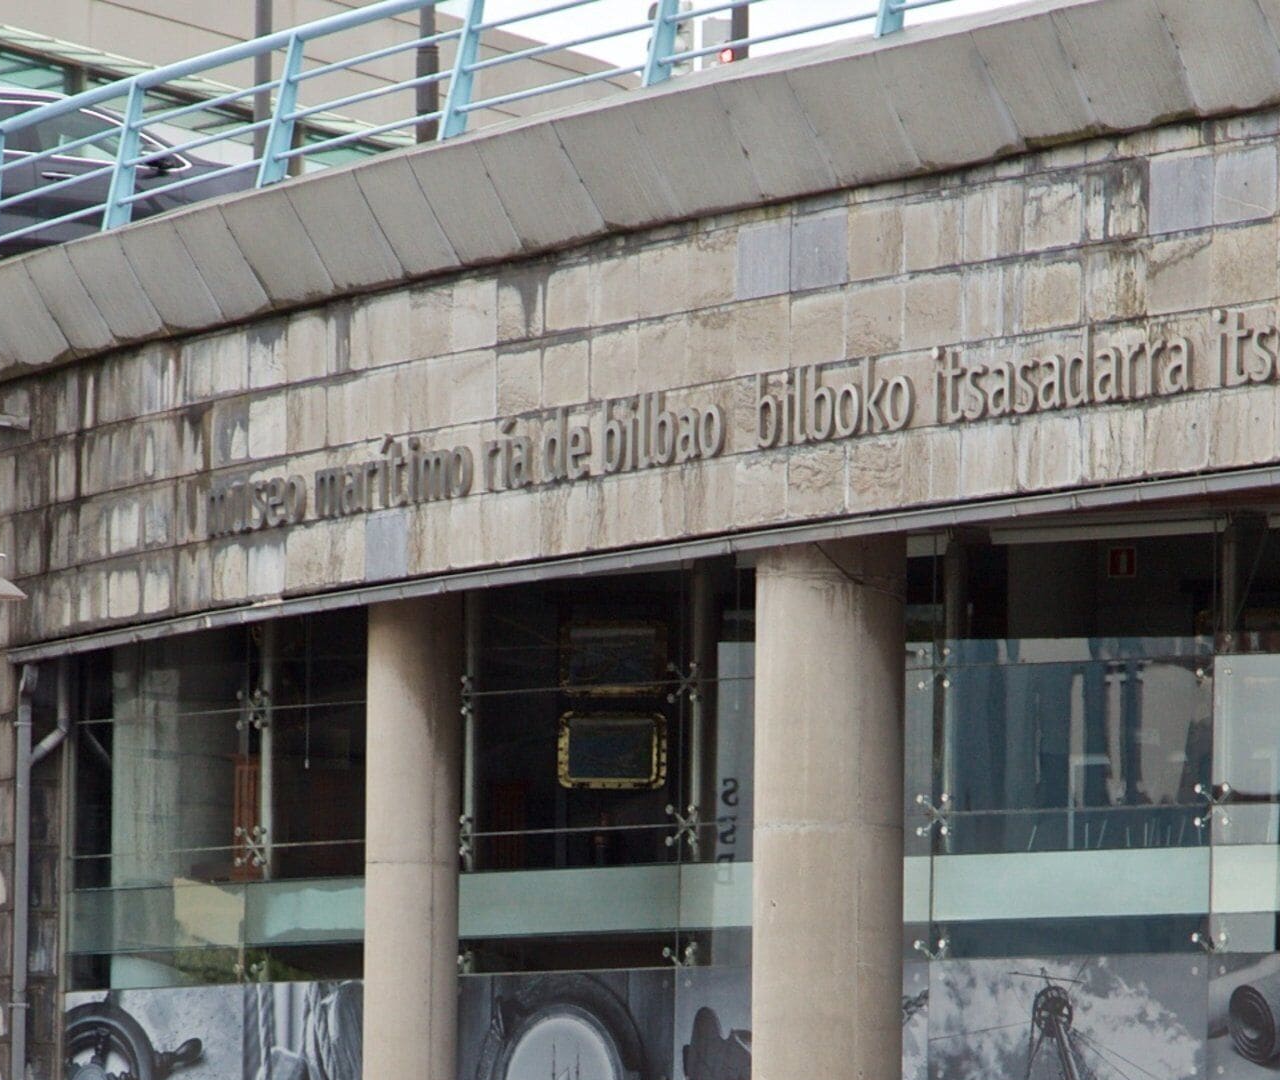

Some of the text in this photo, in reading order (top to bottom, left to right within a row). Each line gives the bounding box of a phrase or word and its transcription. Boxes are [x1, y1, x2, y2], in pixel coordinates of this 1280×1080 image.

[206, 474, 307, 538] museo
[315, 433, 473, 517] marítimo
[483, 415, 532, 491] ría
[544, 407, 592, 481] de
[601, 391, 726, 472] bilbao
[756, 356, 915, 448] bilboko
[931, 323, 1195, 424] itsasadarra
